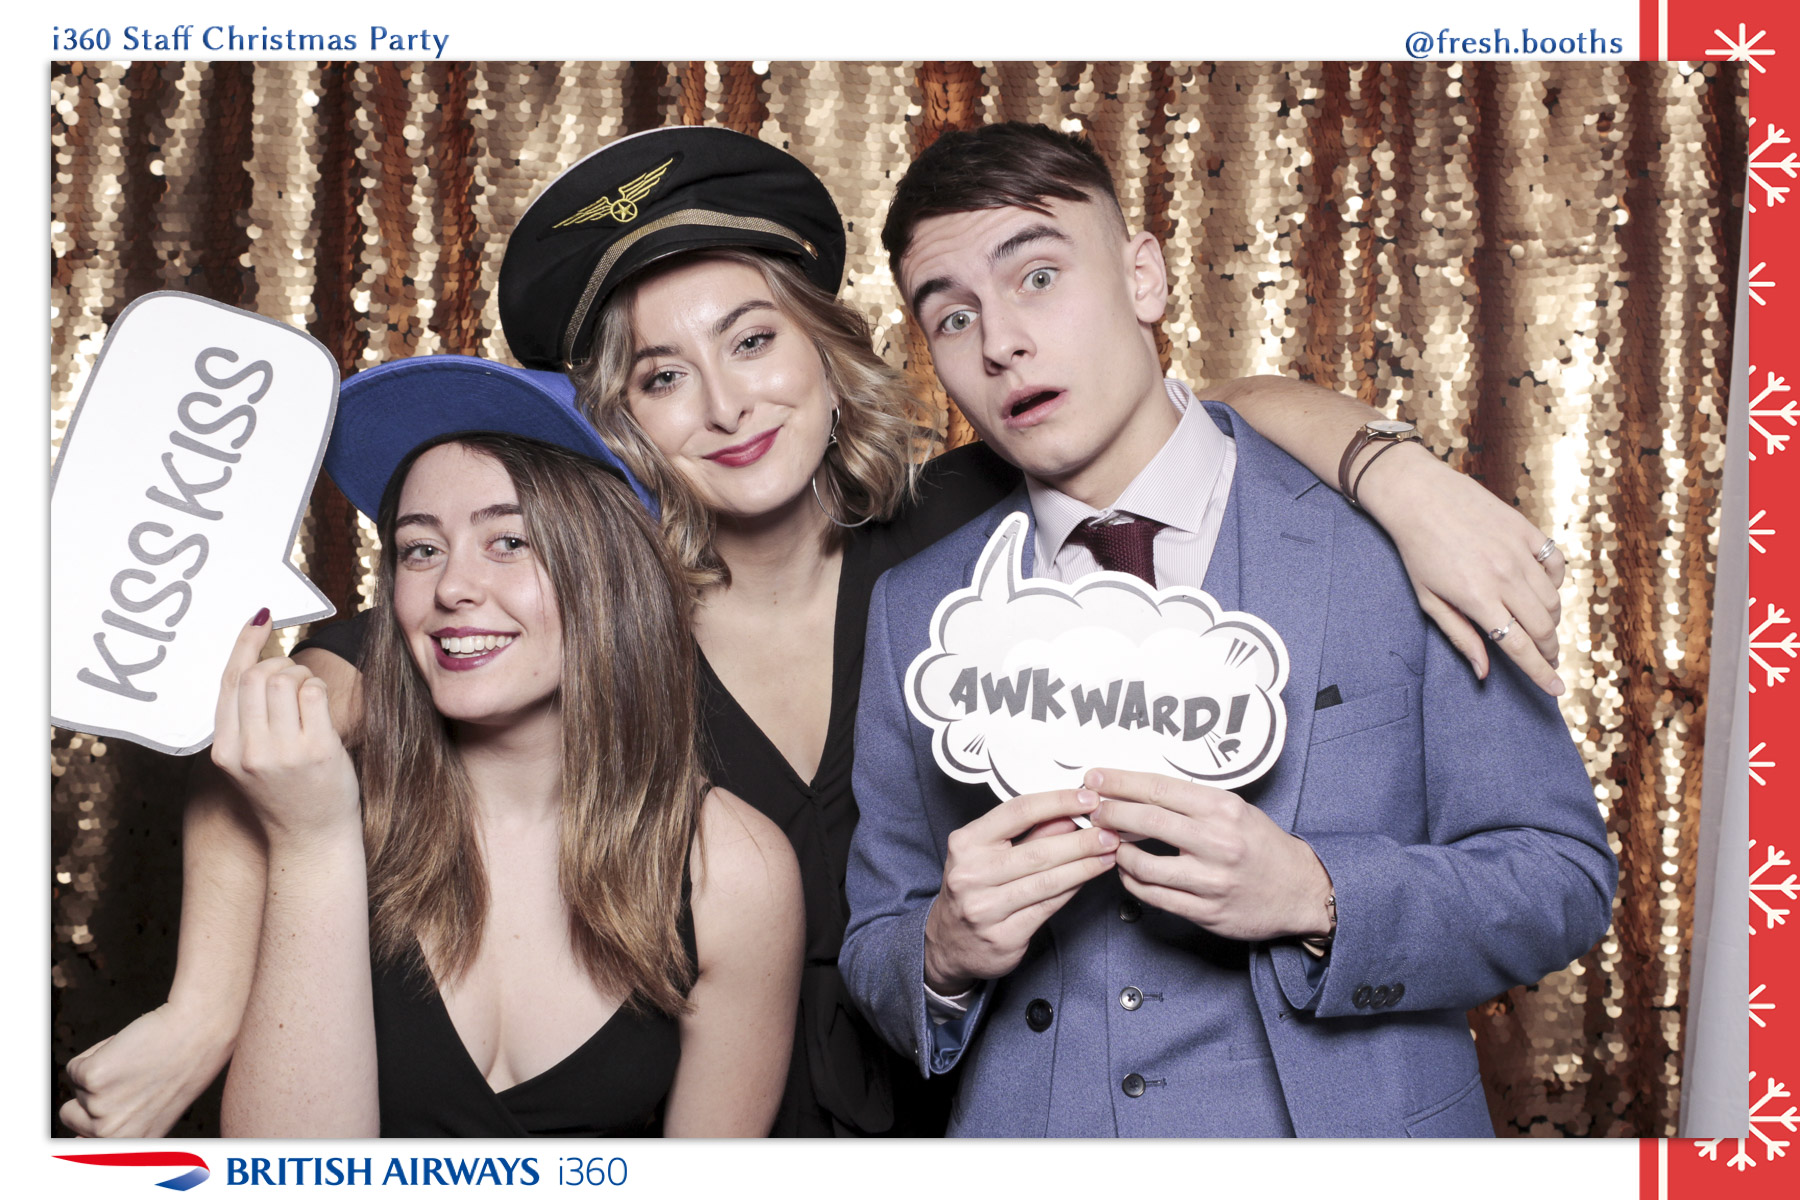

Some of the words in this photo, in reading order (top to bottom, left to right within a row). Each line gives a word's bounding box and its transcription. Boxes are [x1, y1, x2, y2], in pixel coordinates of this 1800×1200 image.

[76, 521, 210, 702] KISS
[145, 346, 274, 521] KISS
[948, 665, 1251, 760] AWKWARD!
